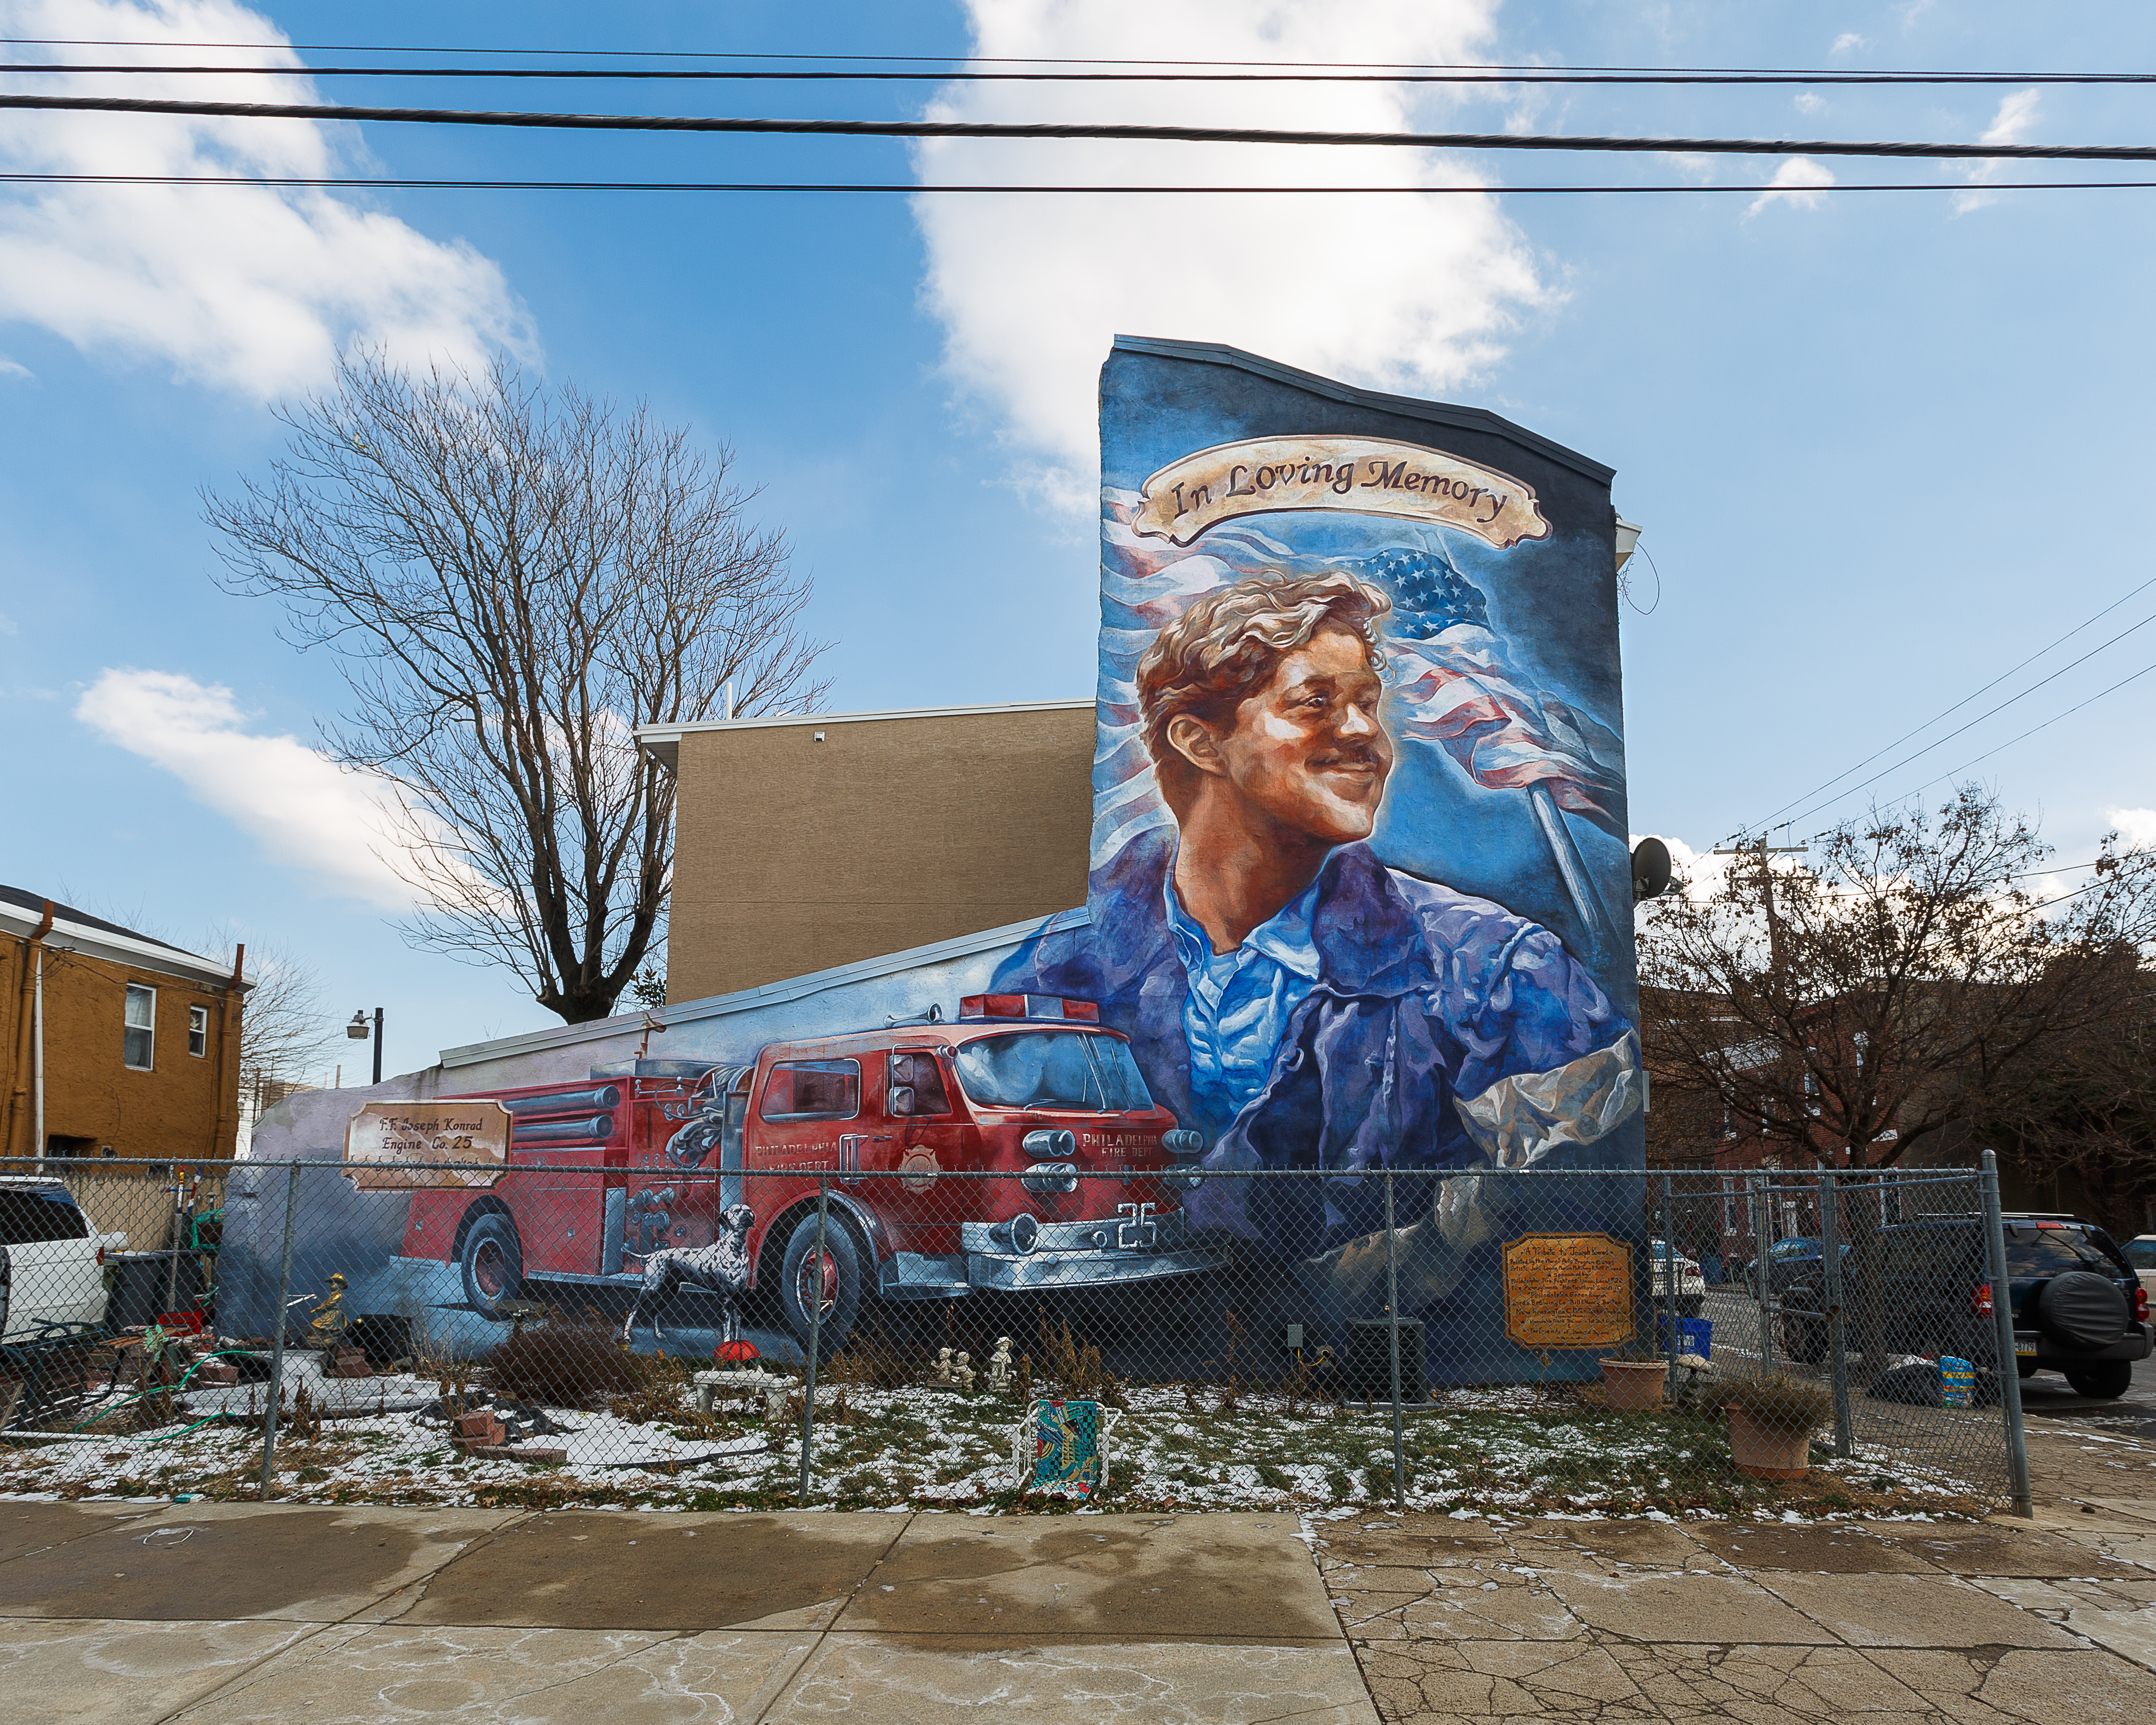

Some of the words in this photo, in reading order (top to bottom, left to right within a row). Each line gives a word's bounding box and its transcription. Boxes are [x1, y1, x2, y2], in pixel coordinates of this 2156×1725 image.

[1171, 482, 1212, 519] In
[1226, 456, 1354, 498] Loving
[1361, 460, 1508, 523] Memory
[379, 1117, 398, 1131] F.F.
[401, 1117, 439, 1134] Joseph
[443, 1118, 483, 1131] Konrad
[382, 1137, 422, 1155] Engine
[432, 1136, 448, 1150] Co.
[452, 1136, 473, 1150] 25
[1082, 1133, 1157, 1147] PHILADELPHIA
[755, 1141, 838, 1157] PHILADELPHIA
[1101, 1147, 1127, 1157] FIRE
[1131, 1147, 1153, 1157] DEPT
[1118, 1202, 1157, 1249] 25
[1532, 1246, 1555, 1255] Tribute
[1569, 1246, 1590, 1258] Joseph
